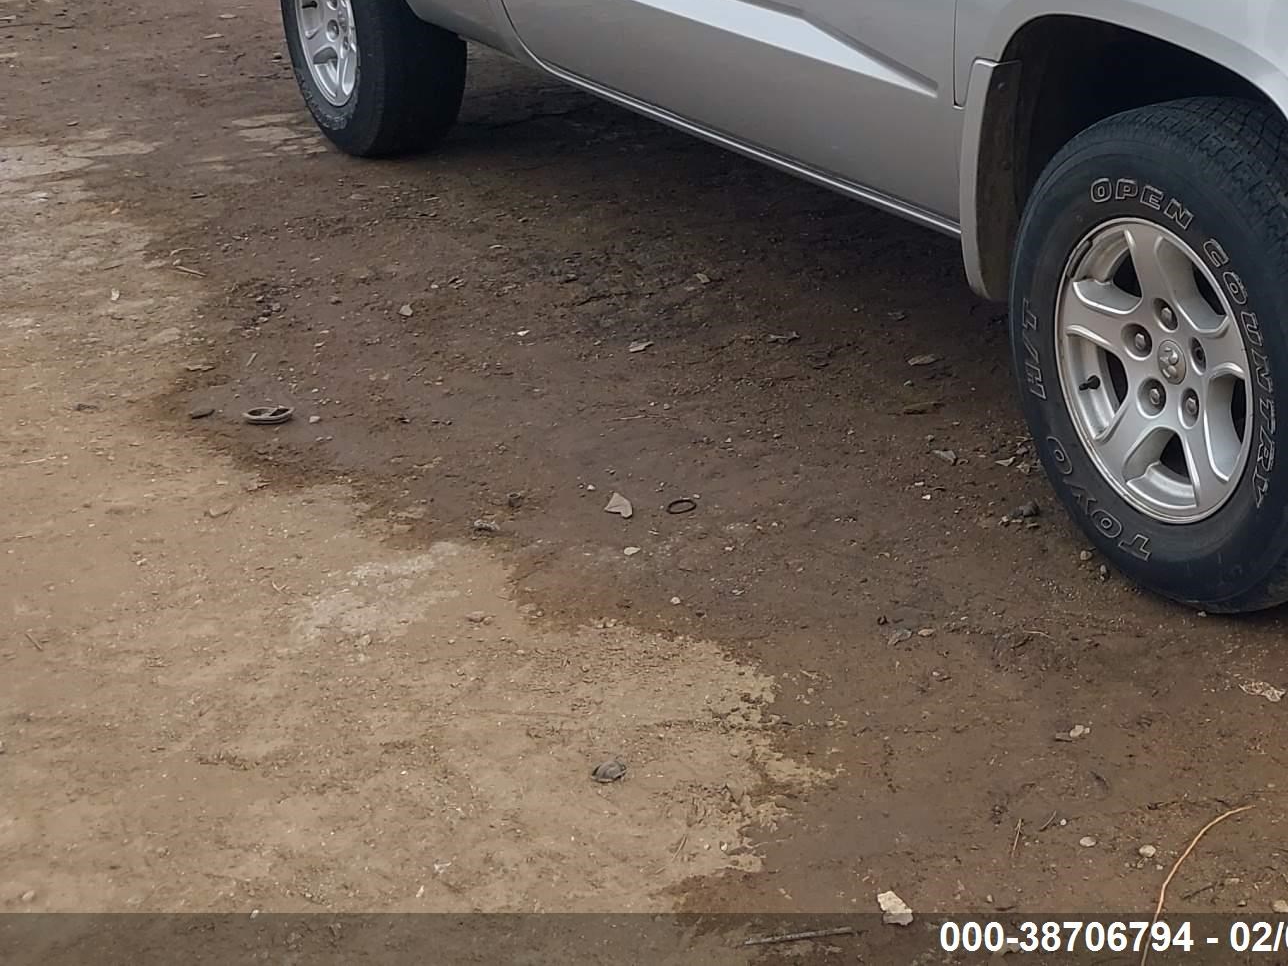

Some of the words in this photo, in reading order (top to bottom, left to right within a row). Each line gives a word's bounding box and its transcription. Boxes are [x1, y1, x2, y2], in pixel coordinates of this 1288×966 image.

[1090, 177, 1195, 231] OPEN
[1203, 237, 1276, 509] COUNTRY
[1047, 435, 1152, 562] TOYO
